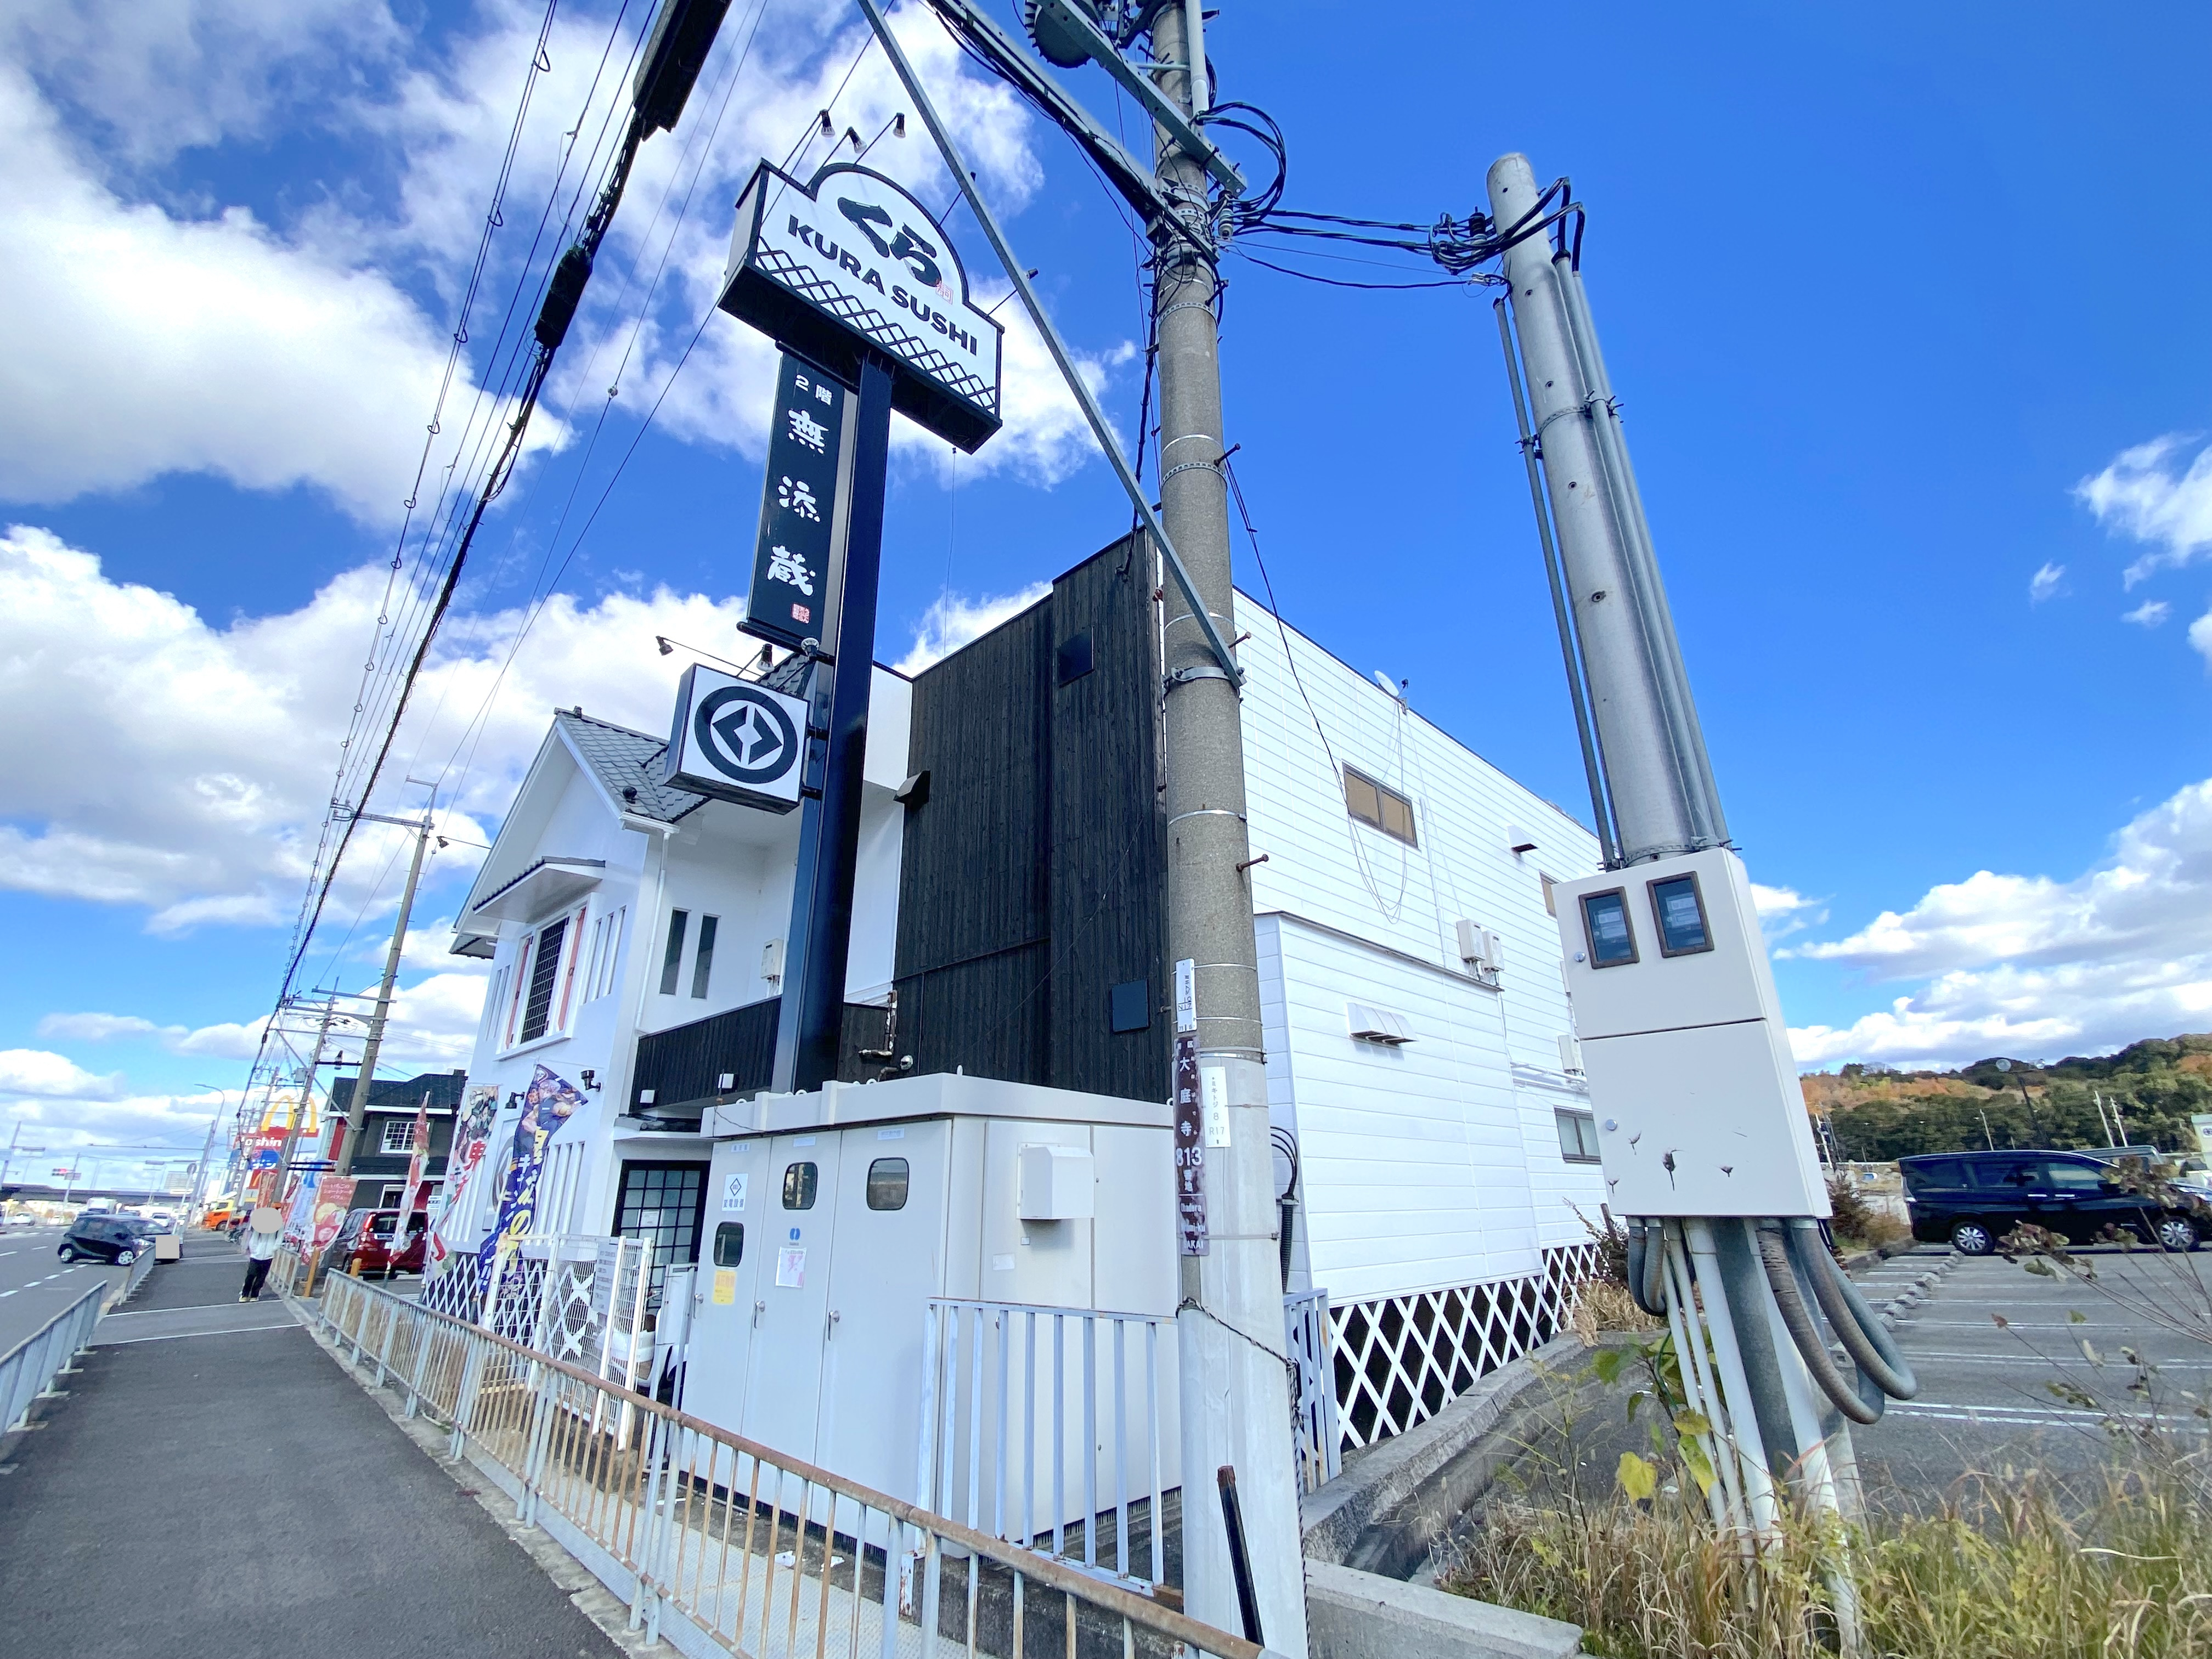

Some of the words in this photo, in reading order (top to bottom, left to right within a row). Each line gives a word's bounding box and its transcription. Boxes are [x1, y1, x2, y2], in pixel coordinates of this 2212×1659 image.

[837, 197, 943, 287] くら
[788, 213, 886, 296] KURA
[890, 285, 978, 357] SUSHI
[795, 374, 832, 406] 2階
[766, 409, 829, 597] 無添蔵
[1180, 1056, 1192, 1137] 大庭寺
[1213, 1112, 1219, 1121] 8
[1176, 1147, 1203, 1166] 813
[1209, 1126, 1225, 1136] R17
